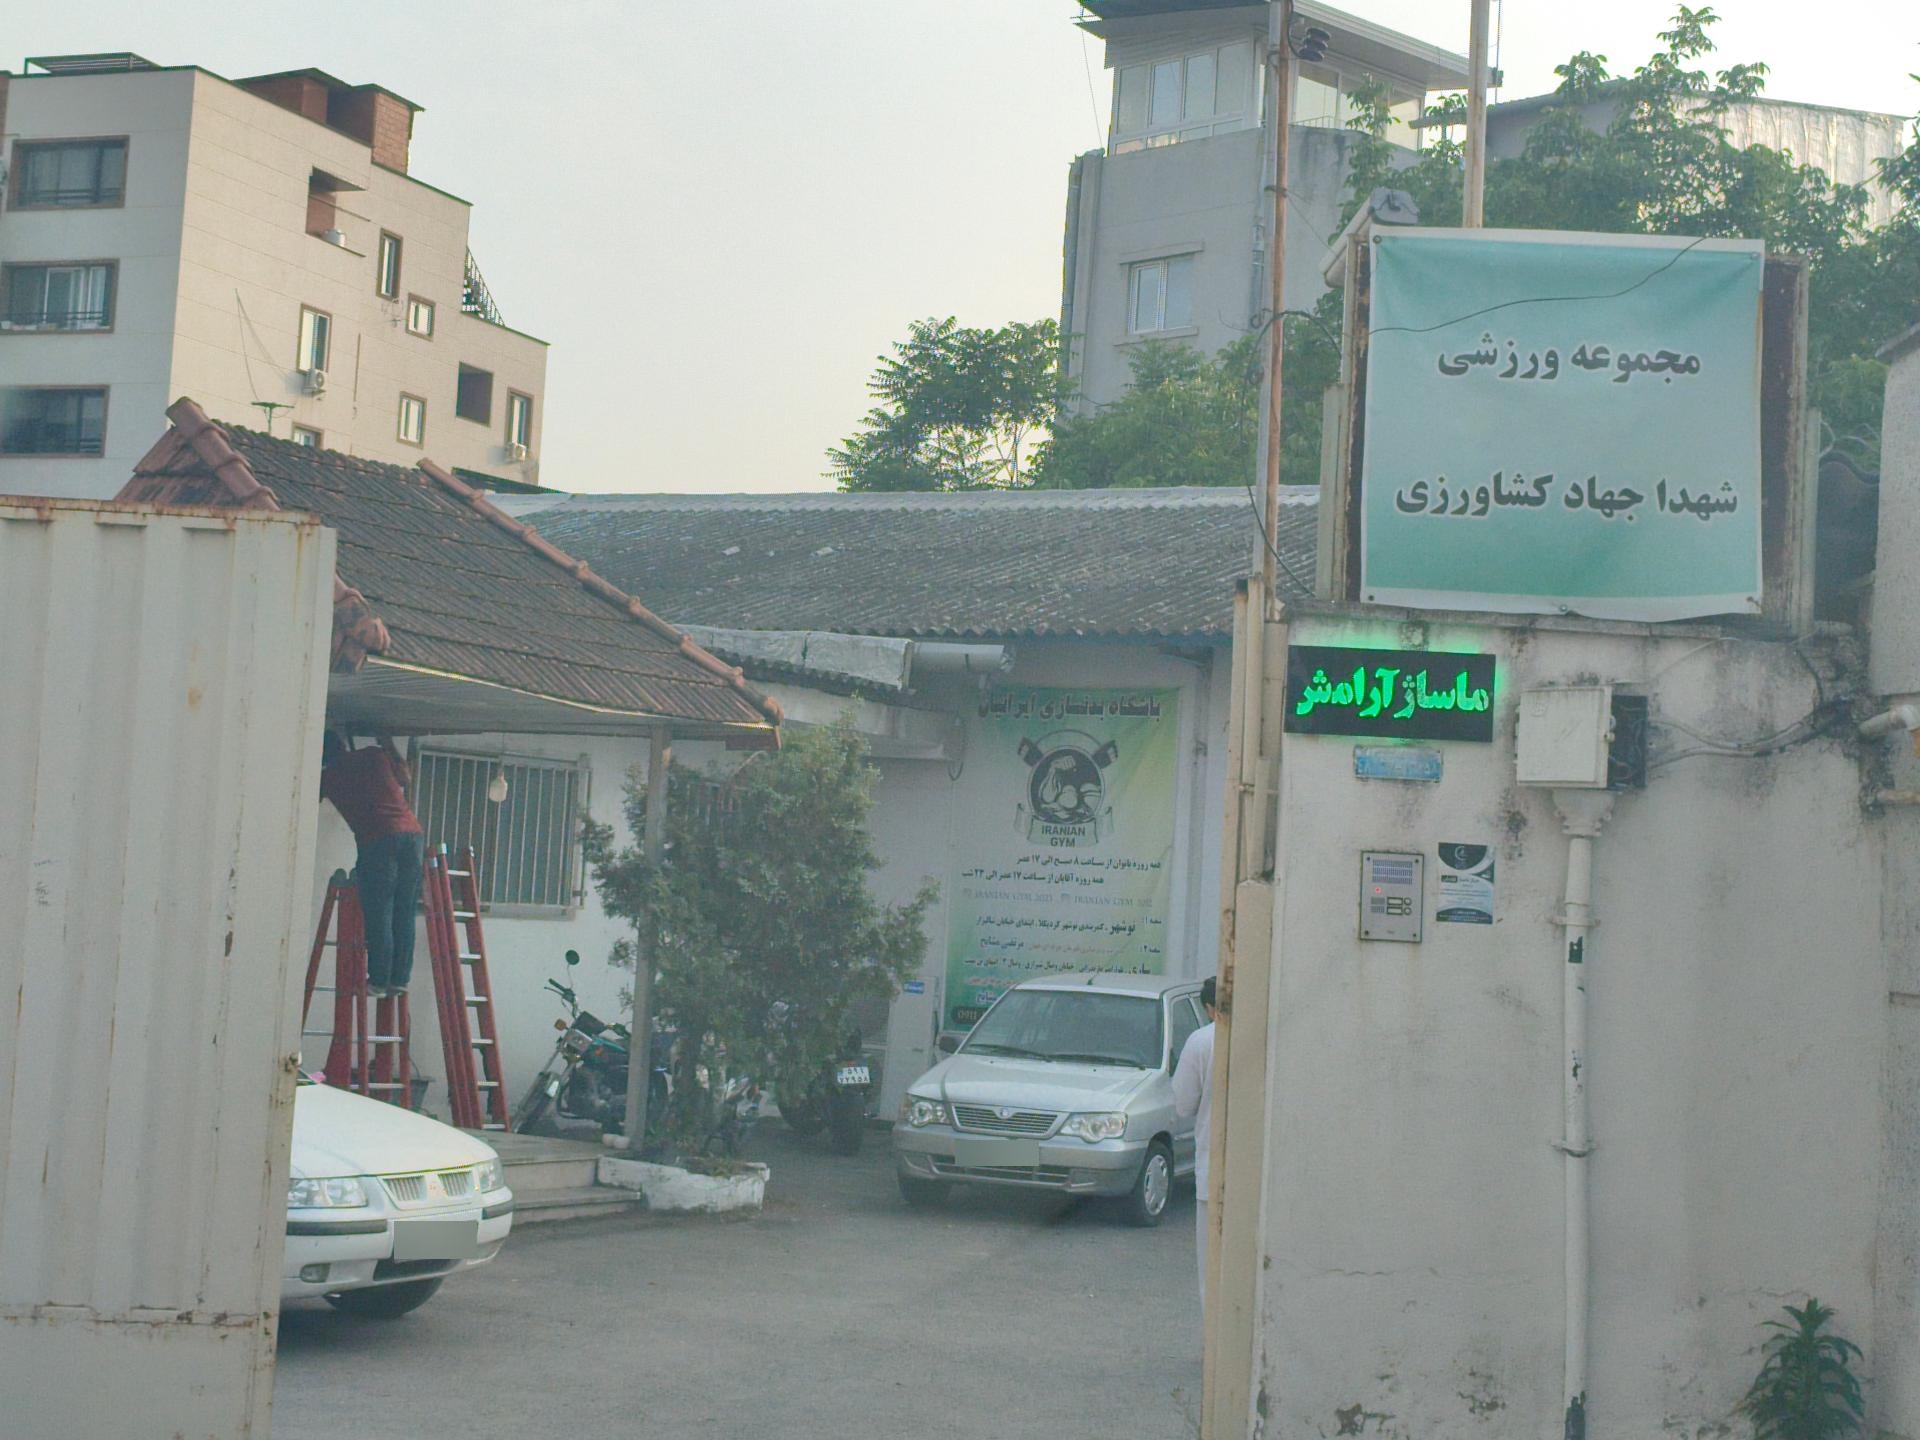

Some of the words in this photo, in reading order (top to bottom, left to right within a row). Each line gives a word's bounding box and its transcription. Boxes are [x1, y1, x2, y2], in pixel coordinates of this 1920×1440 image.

[1437, 332, 1560, 381] ورزشی
[1570, 341, 1702, 384] مجموعه
[1395, 469, 1554, 517] کشاورزی
[1564, 474, 1645, 522] جهاد
[1655, 477, 1739, 522] شهدا
[977, 691, 1037, 719] ایرانیان
[1039, 693, 1105, 722] بدنسازی
[1108, 694, 1161, 723] باشگاه
[1295, 666, 1401, 718] آرامش
[1393, 669, 1490, 719] ماساژ
[1041, 824, 1086, 837] IRANIAN
[1050, 837, 1076, 848] GYM
